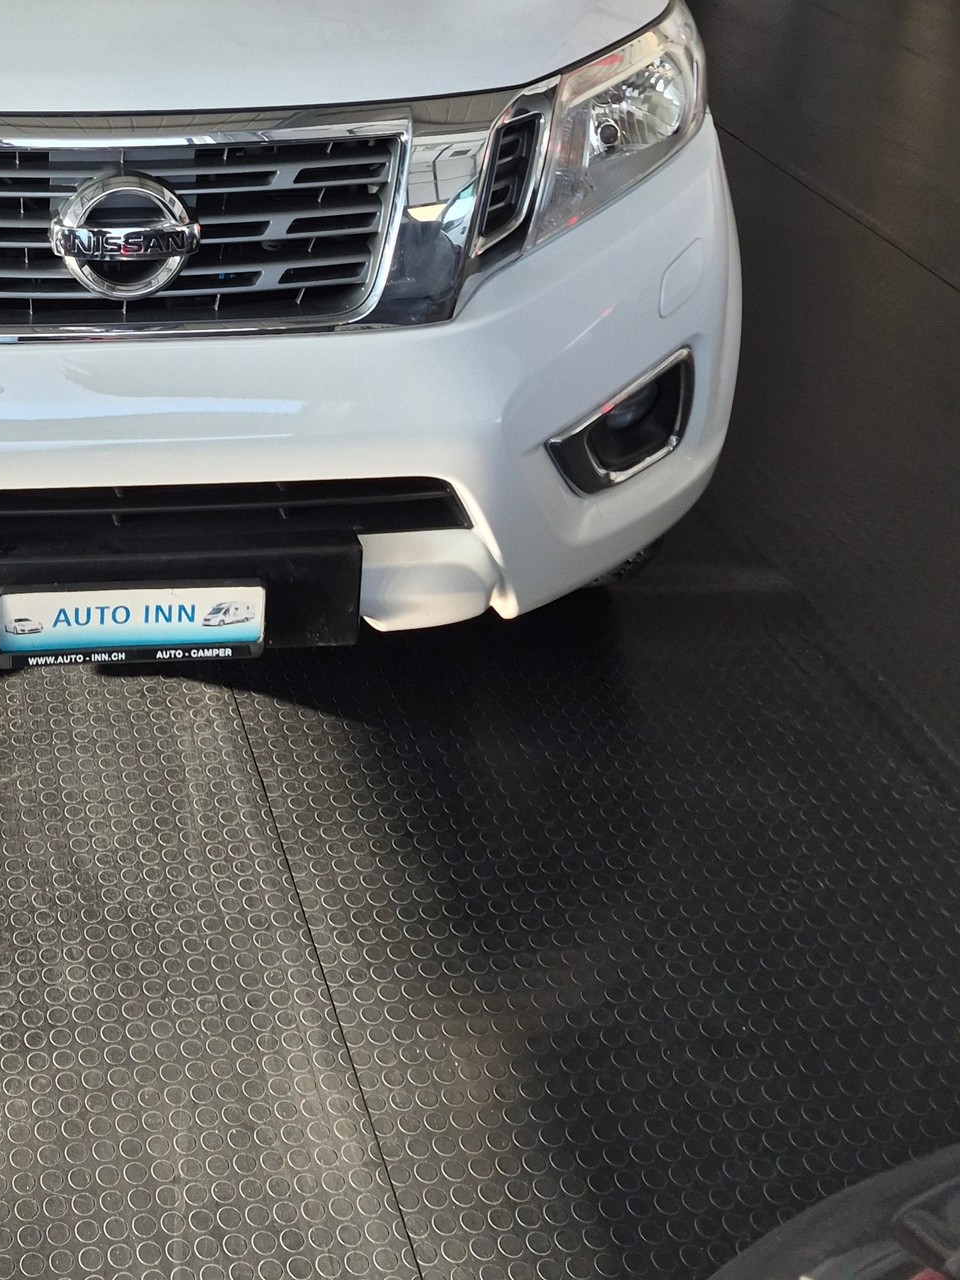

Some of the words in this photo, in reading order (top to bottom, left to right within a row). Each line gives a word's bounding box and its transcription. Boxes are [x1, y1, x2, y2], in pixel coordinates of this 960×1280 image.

[69, 231, 186, 254] NISSAN
[52, 605, 131, 628] AUTO
[144, 604, 196, 624] INN
[28, 653, 84, 666] WWW.AUTO
[91, 652, 126, 662] INN.CH
[156, 649, 182, 659] AUTO
[191, 648, 232, 658] CAMPER
